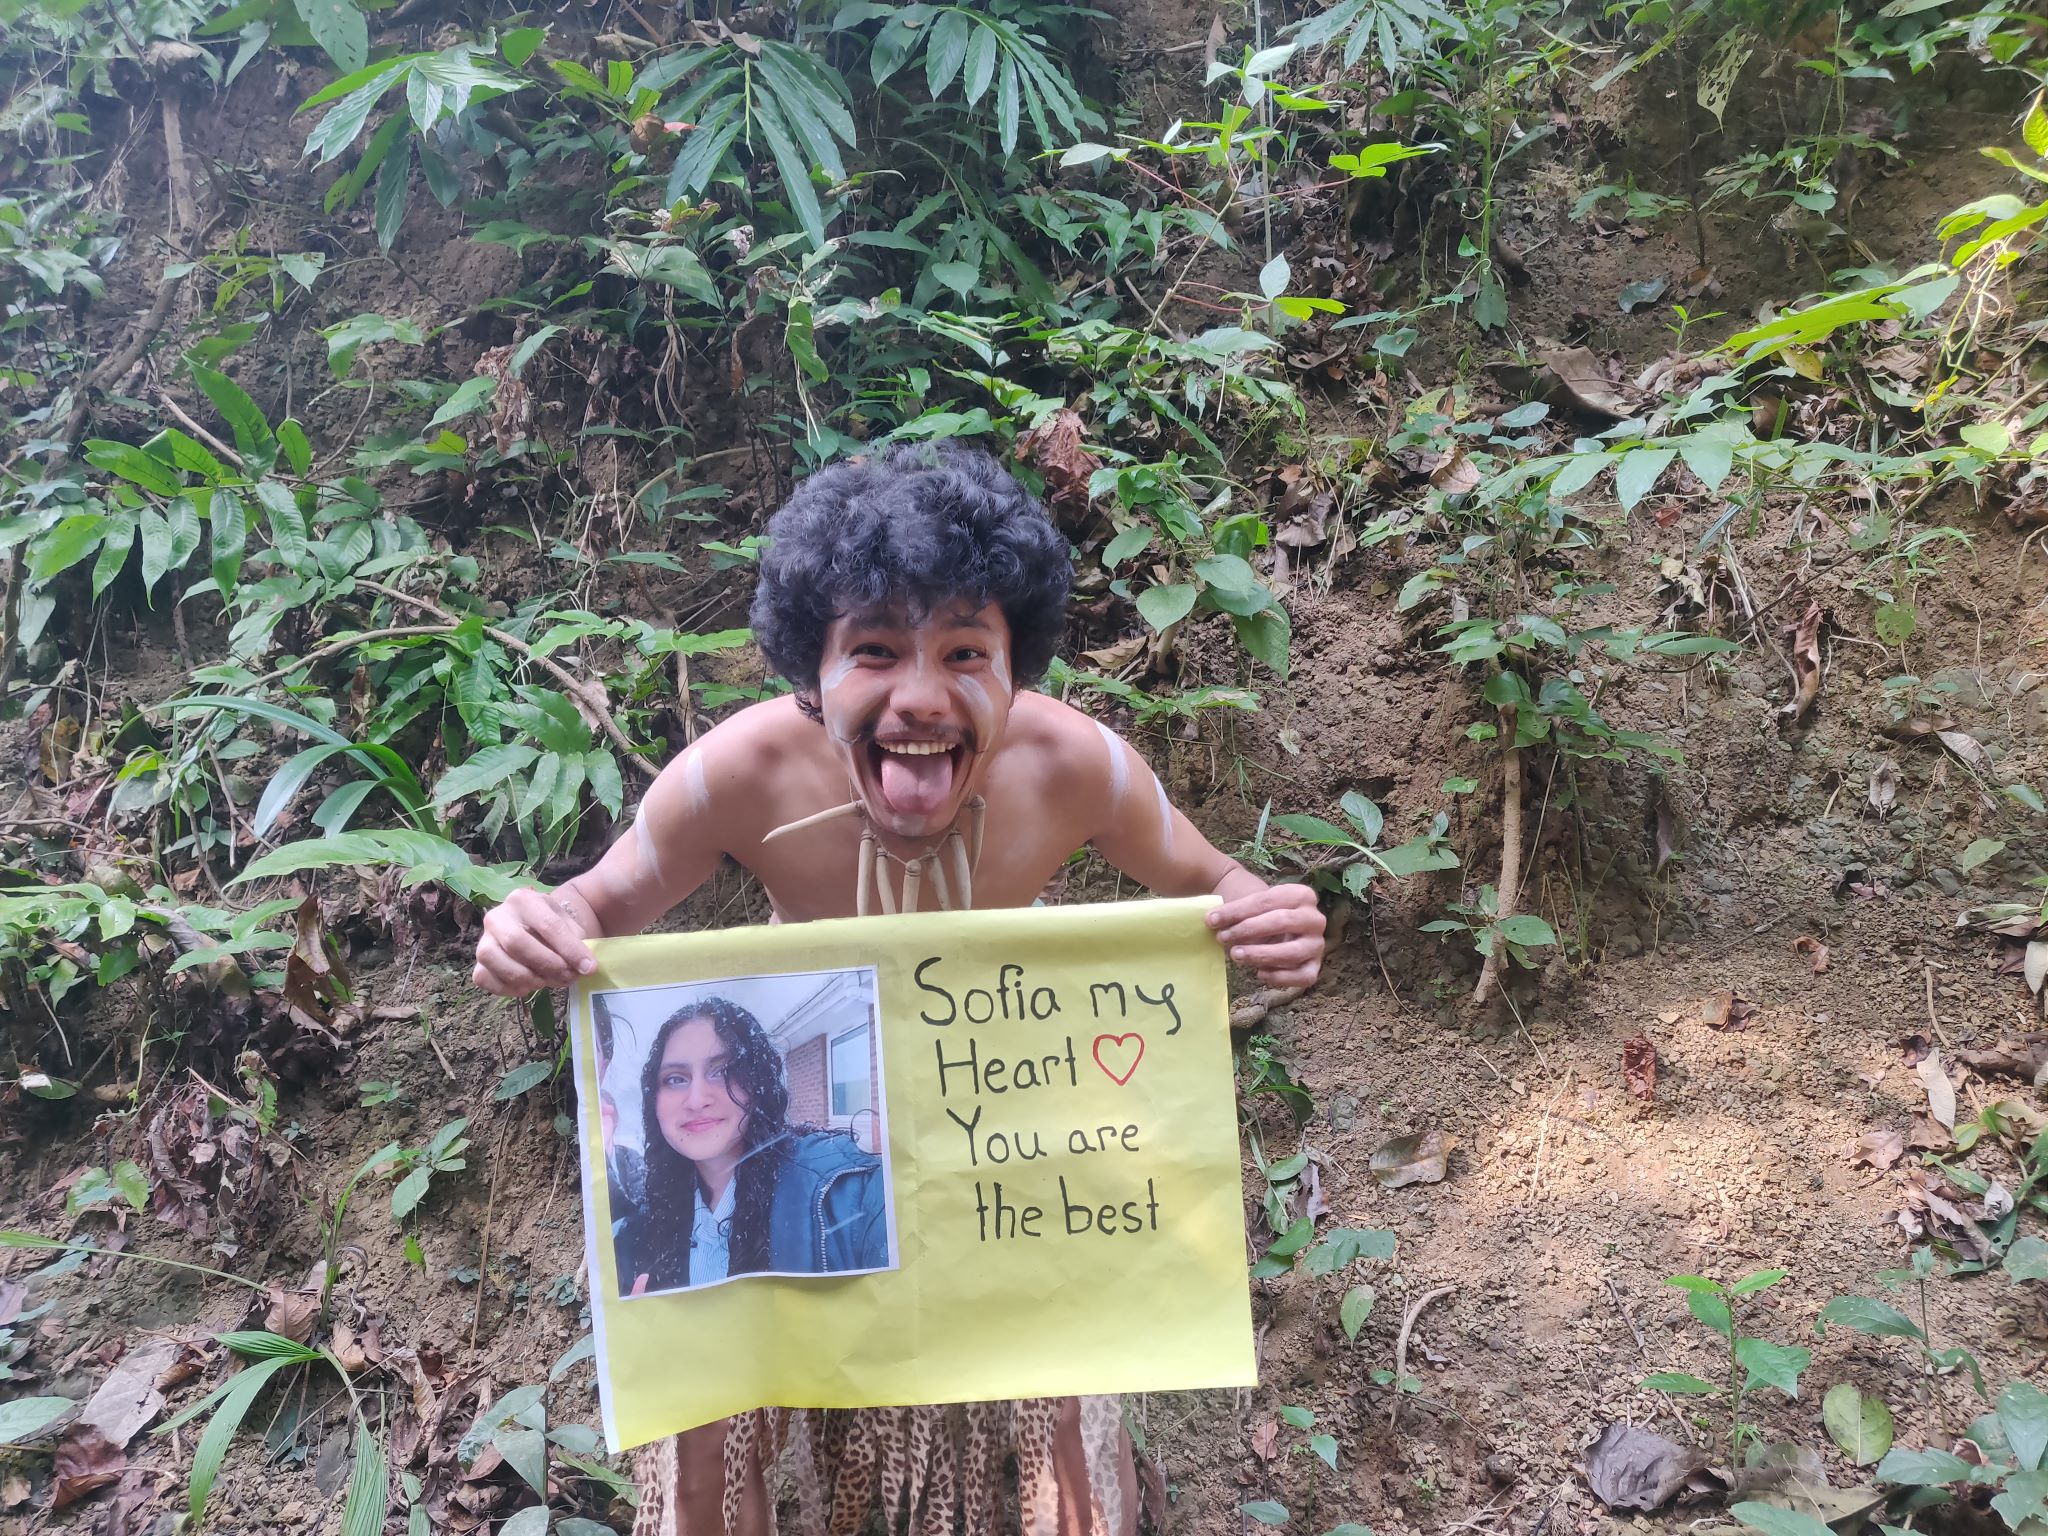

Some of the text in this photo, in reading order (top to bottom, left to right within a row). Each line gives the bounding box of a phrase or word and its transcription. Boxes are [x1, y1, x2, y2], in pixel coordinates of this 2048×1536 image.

[914, 956, 1182, 1036] Sofia my
[936, 1036, 1077, 1097] Heart
[946, 1105, 1140, 1167] You are
[975, 1175, 1160, 1242] the best
